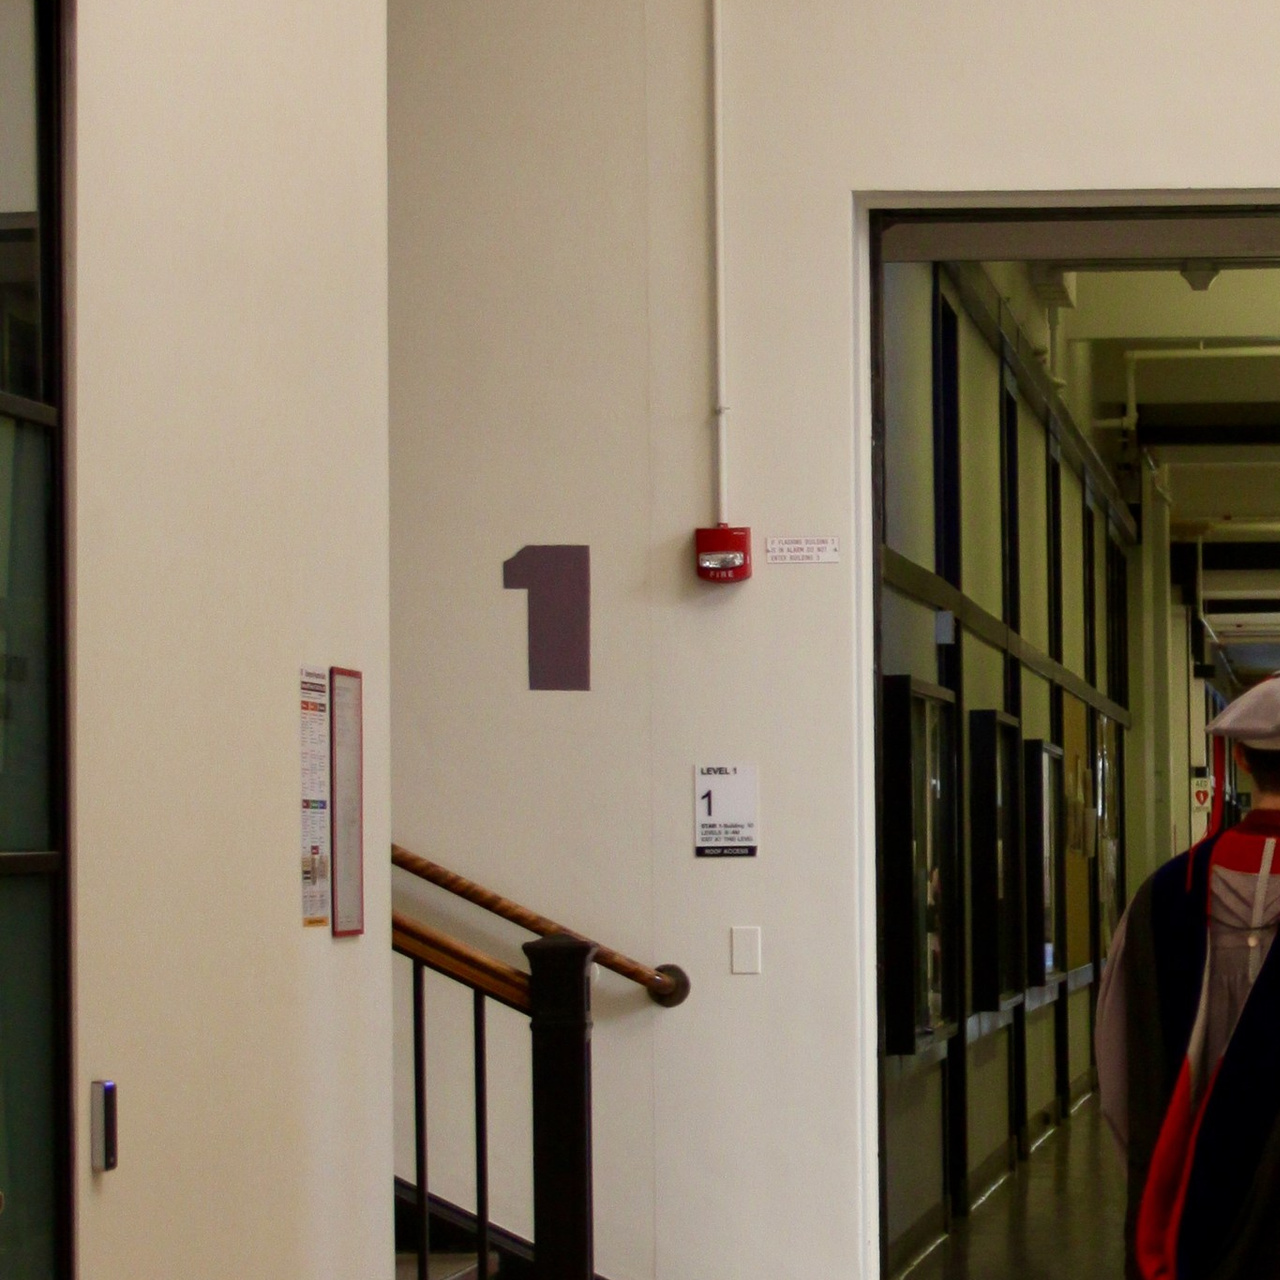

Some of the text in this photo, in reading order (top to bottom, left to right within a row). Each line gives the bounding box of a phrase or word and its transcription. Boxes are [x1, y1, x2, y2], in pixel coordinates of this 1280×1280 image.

[709, 570, 734, 578] FIRE
[503, 545, 591, 691] 1
[700, 767, 737, 775] LEVEL 1
[701, 789, 712, 817] 1
